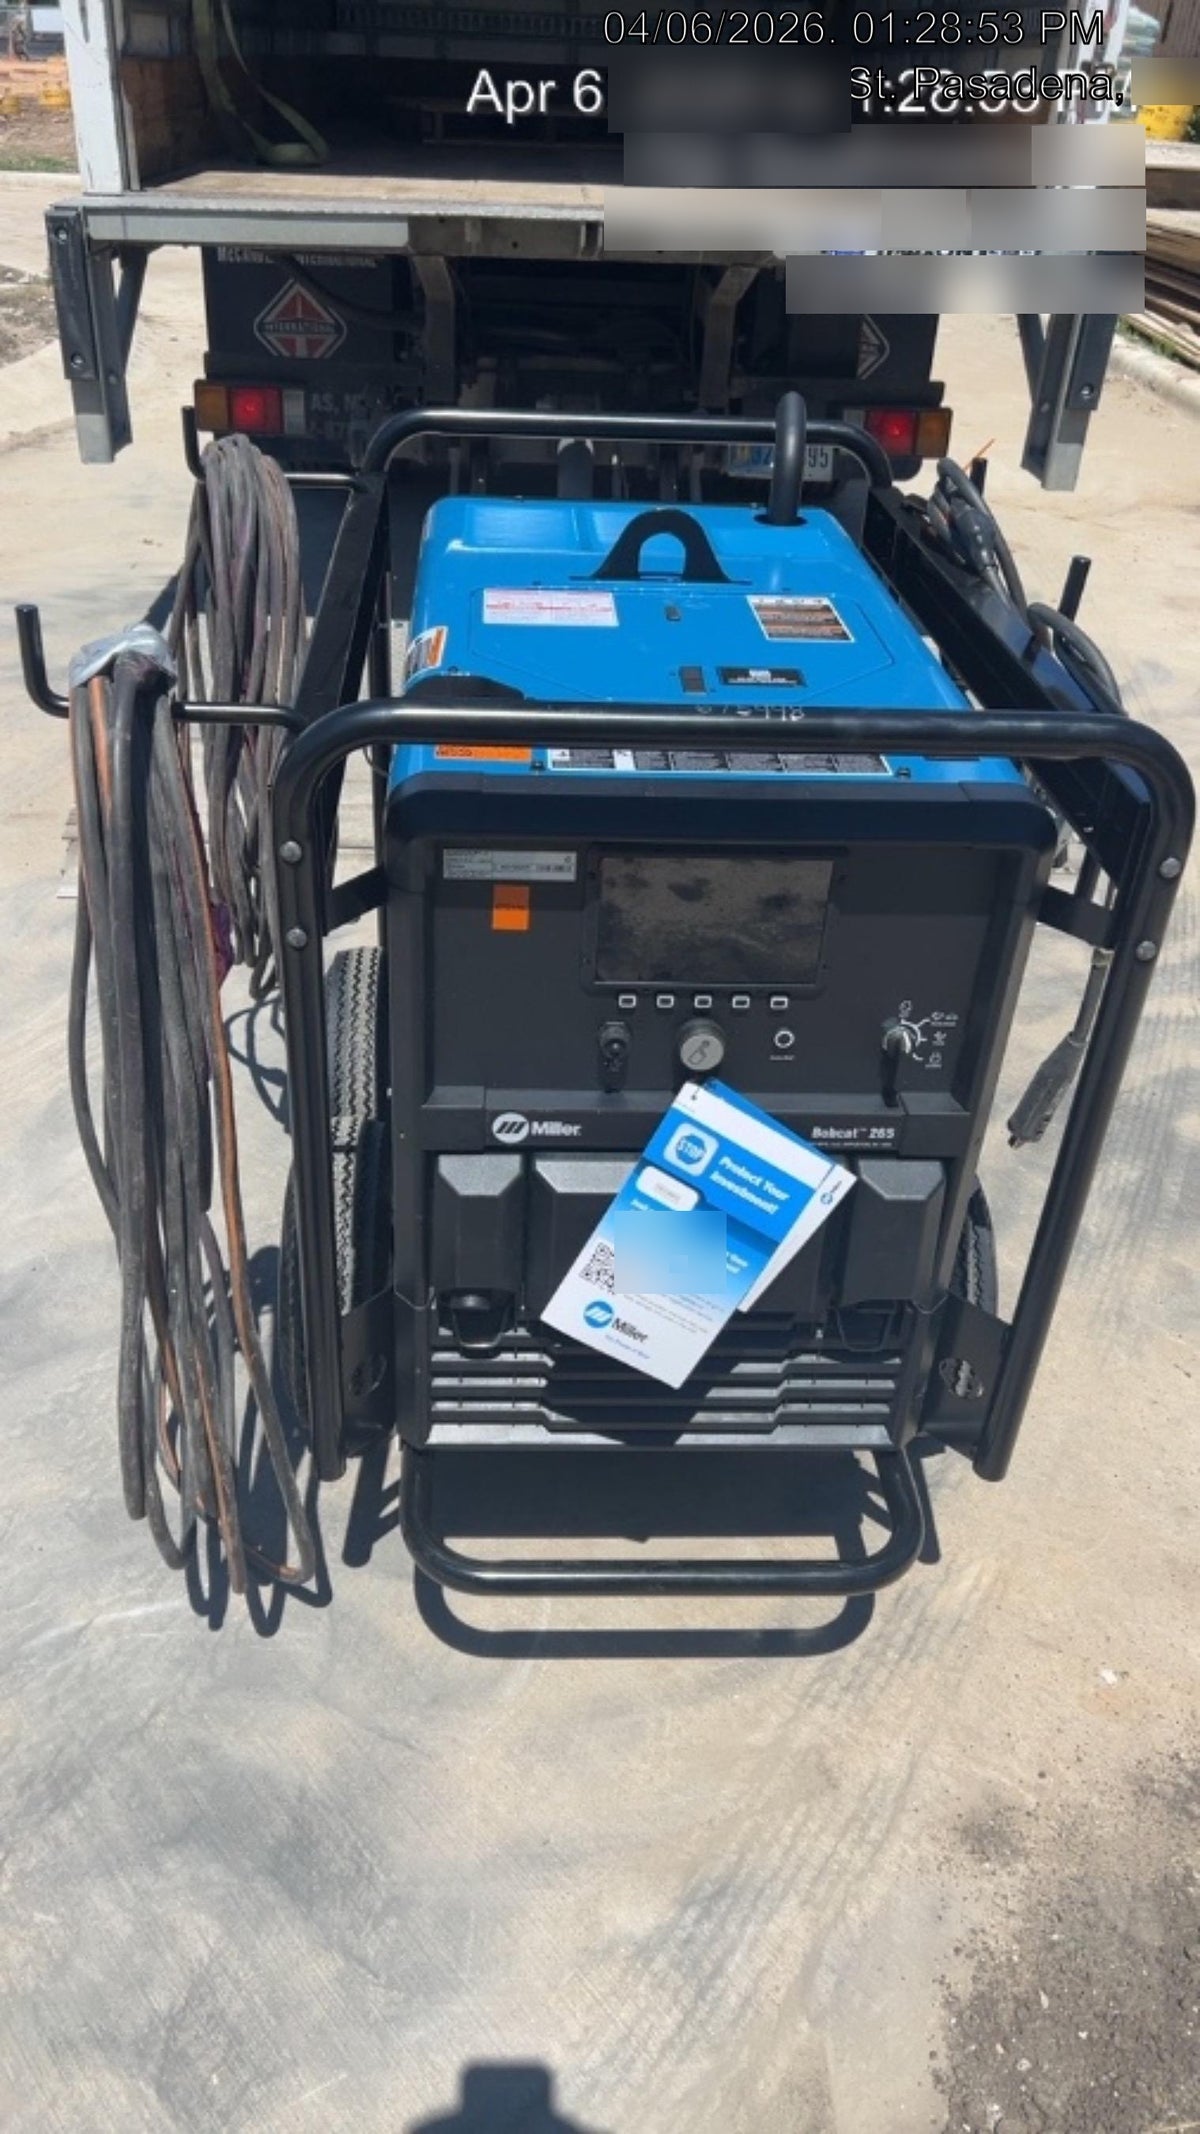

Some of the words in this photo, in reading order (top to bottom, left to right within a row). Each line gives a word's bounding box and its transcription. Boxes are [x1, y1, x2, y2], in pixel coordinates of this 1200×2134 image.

[530, 1119, 582, 1137] Miller
[868, 1126, 895, 1139] 265
[611, 1317, 649, 1344] Miller
